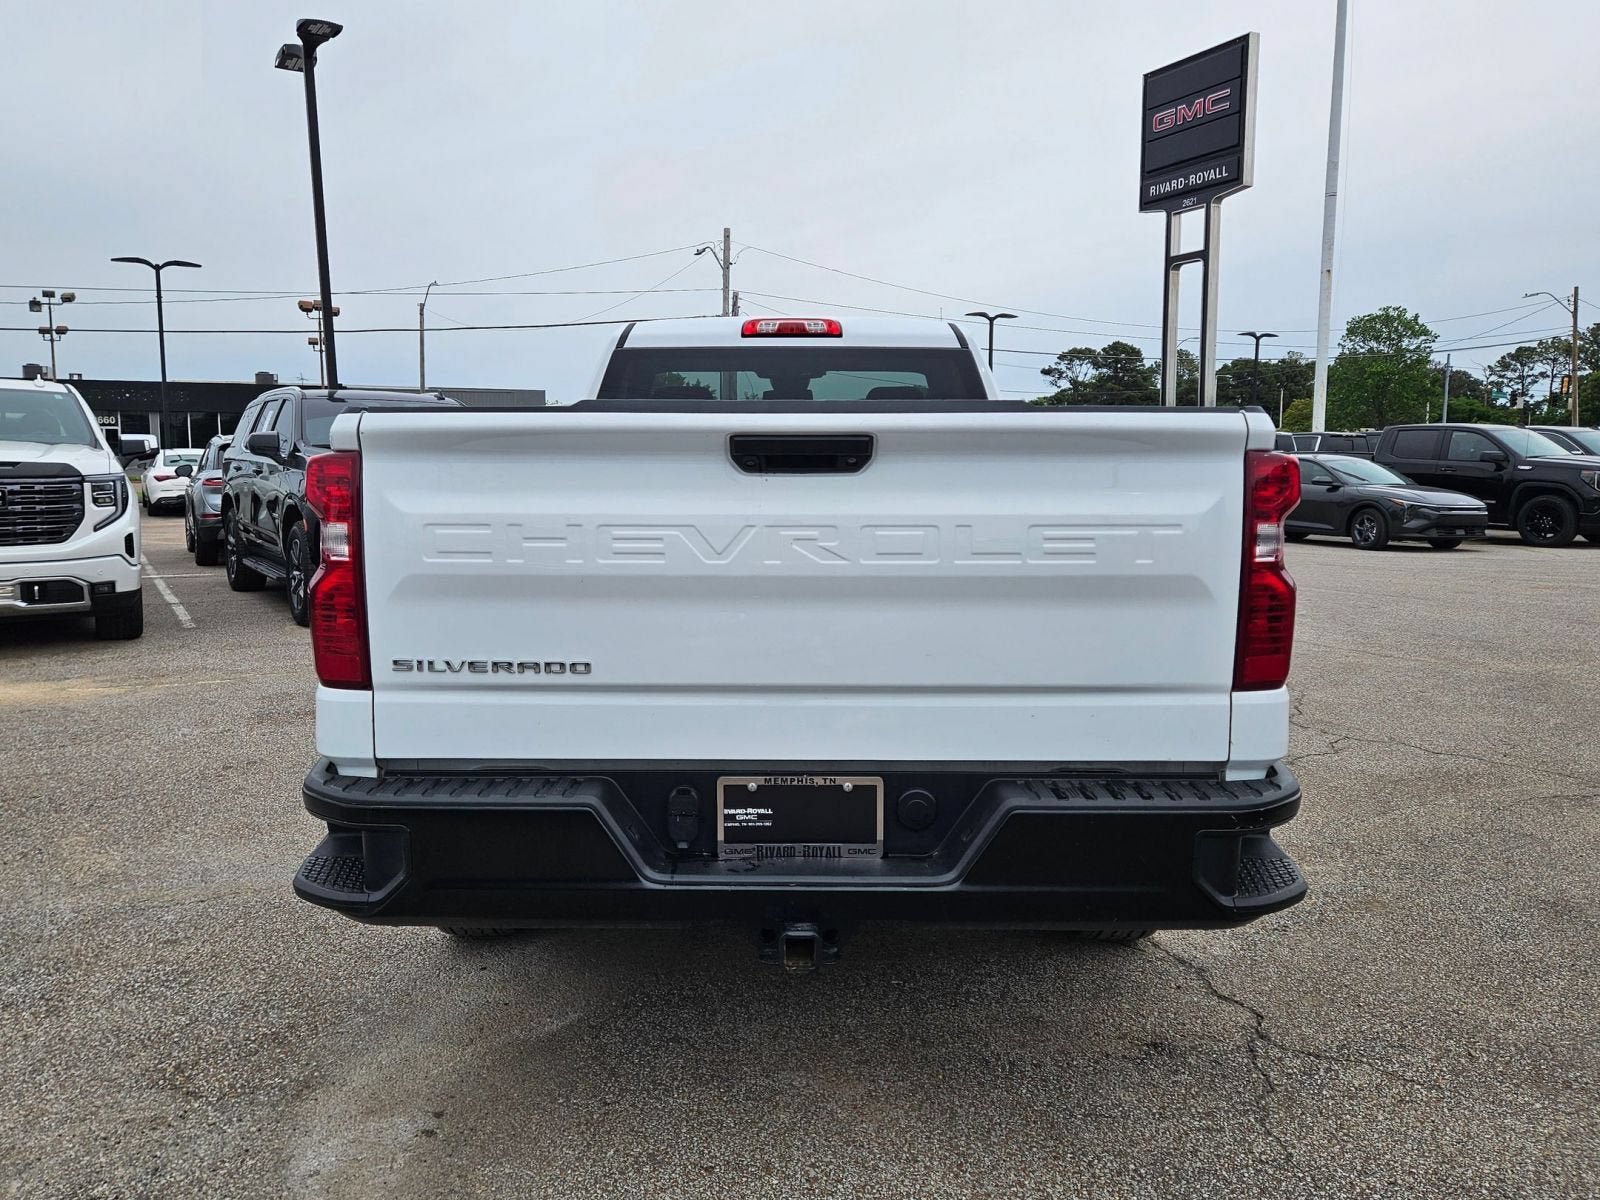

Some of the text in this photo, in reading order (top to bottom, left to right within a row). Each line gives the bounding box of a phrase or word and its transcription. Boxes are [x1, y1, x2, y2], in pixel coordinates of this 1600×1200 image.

[1153, 89, 1230, 132] GMC
[1149, 165, 1229, 197] RIVARD-ROYALL
[1182, 197, 1197, 207] 2621
[96, 416, 115, 424] 660
[423, 522, 1183, 564] CHEVROLET
[392, 658, 592, 675] SILVERADO
[822, 777, 837, 785] TN
